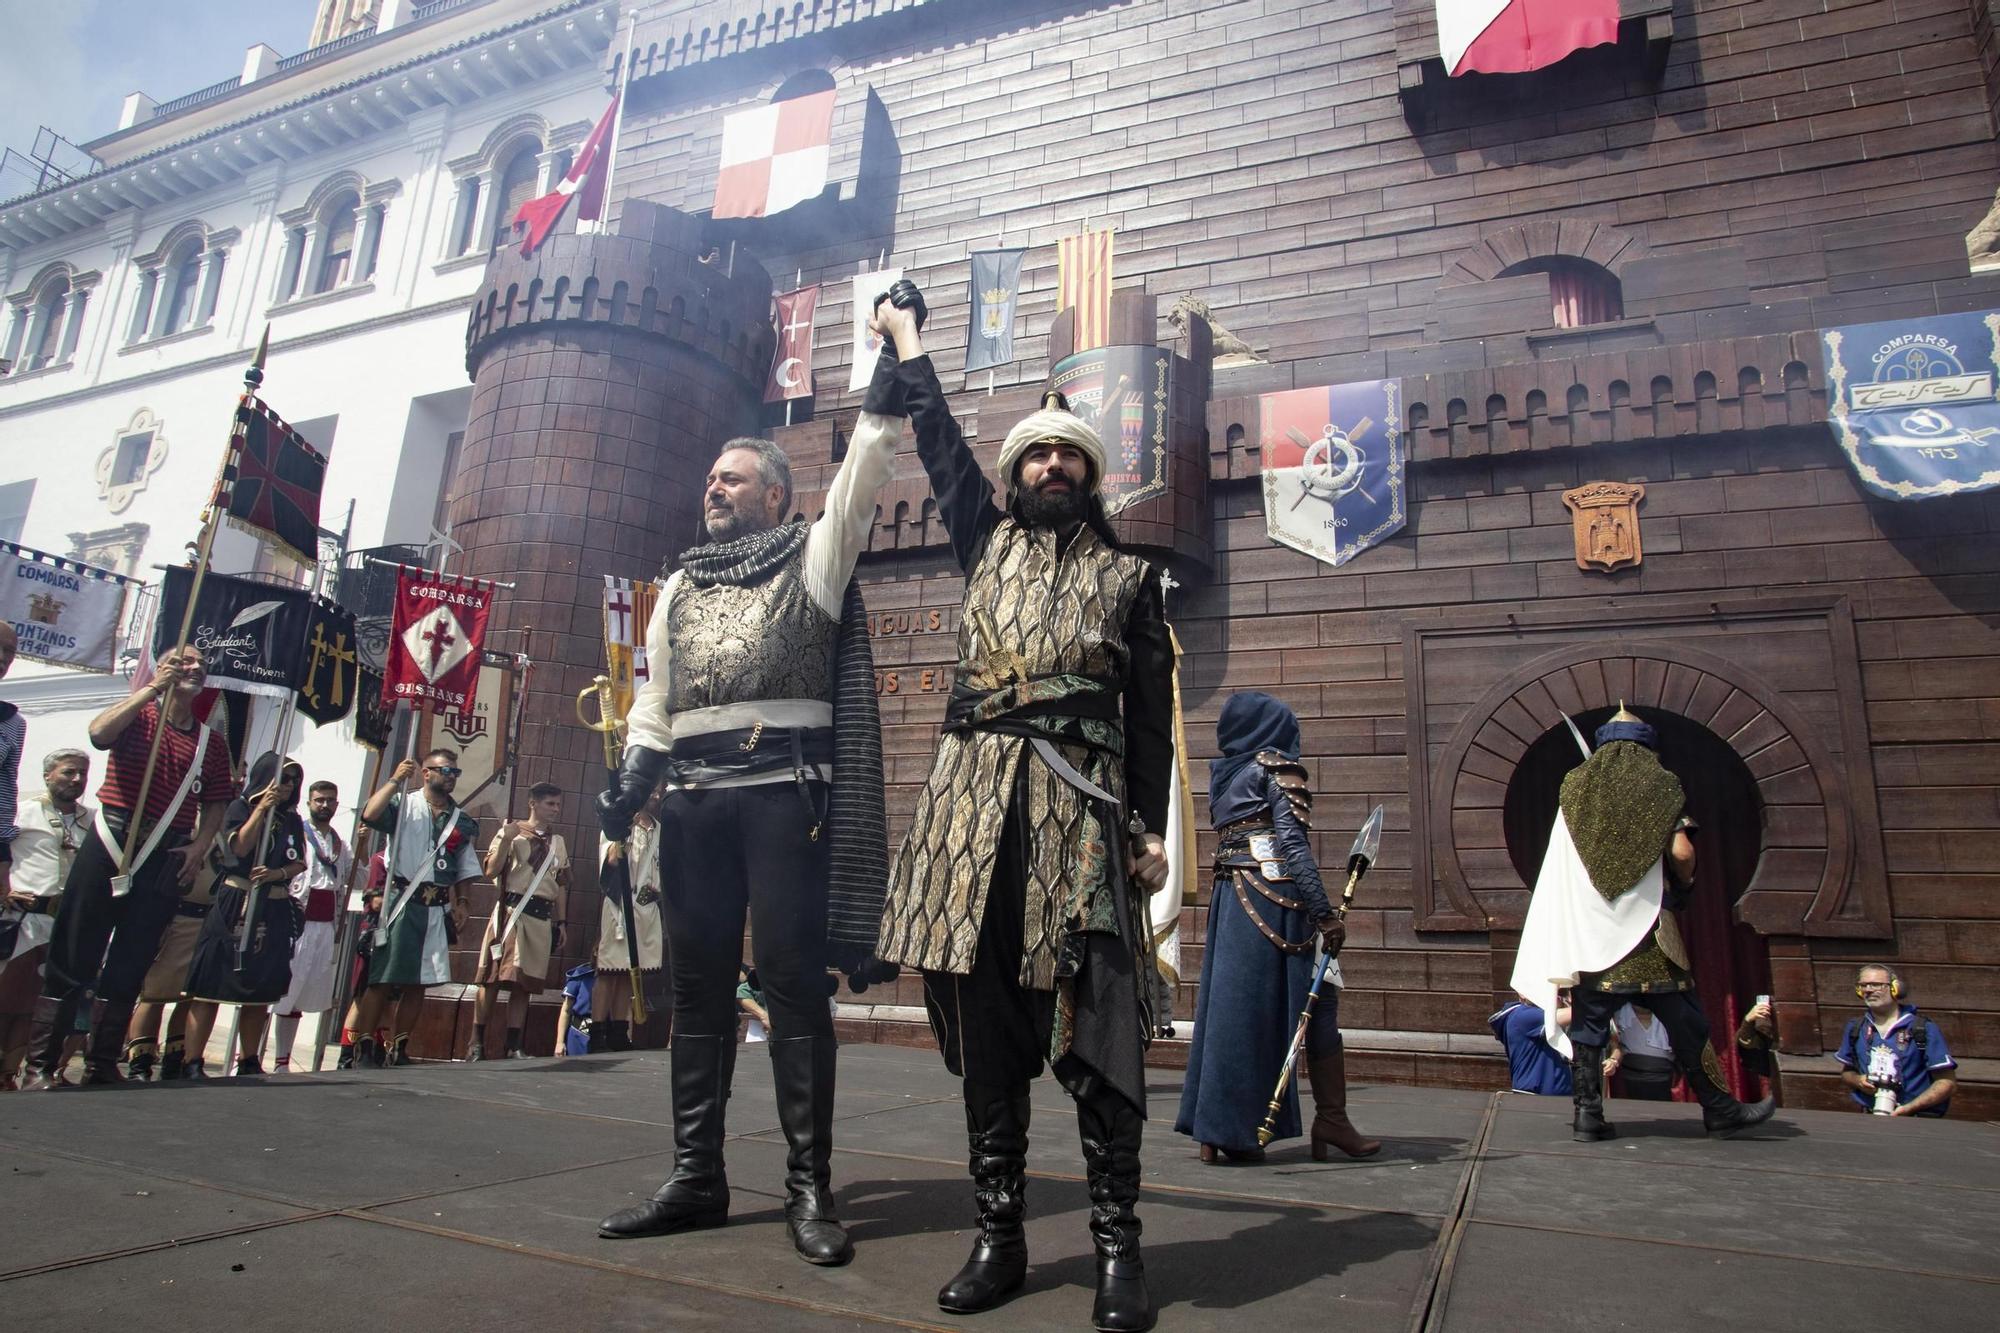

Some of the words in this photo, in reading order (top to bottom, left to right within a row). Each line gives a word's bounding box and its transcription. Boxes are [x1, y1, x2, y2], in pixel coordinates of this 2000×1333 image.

[1872, 333, 1959, 364] COMPARSA
[1323, 517, 1349, 529] 1860
[17, 564, 80, 592] COMPARSA
[410, 586, 483, 608] COMPARSA
[8, 621, 76, 649] ONTANOS
[20, 640, 50, 656] 1940
